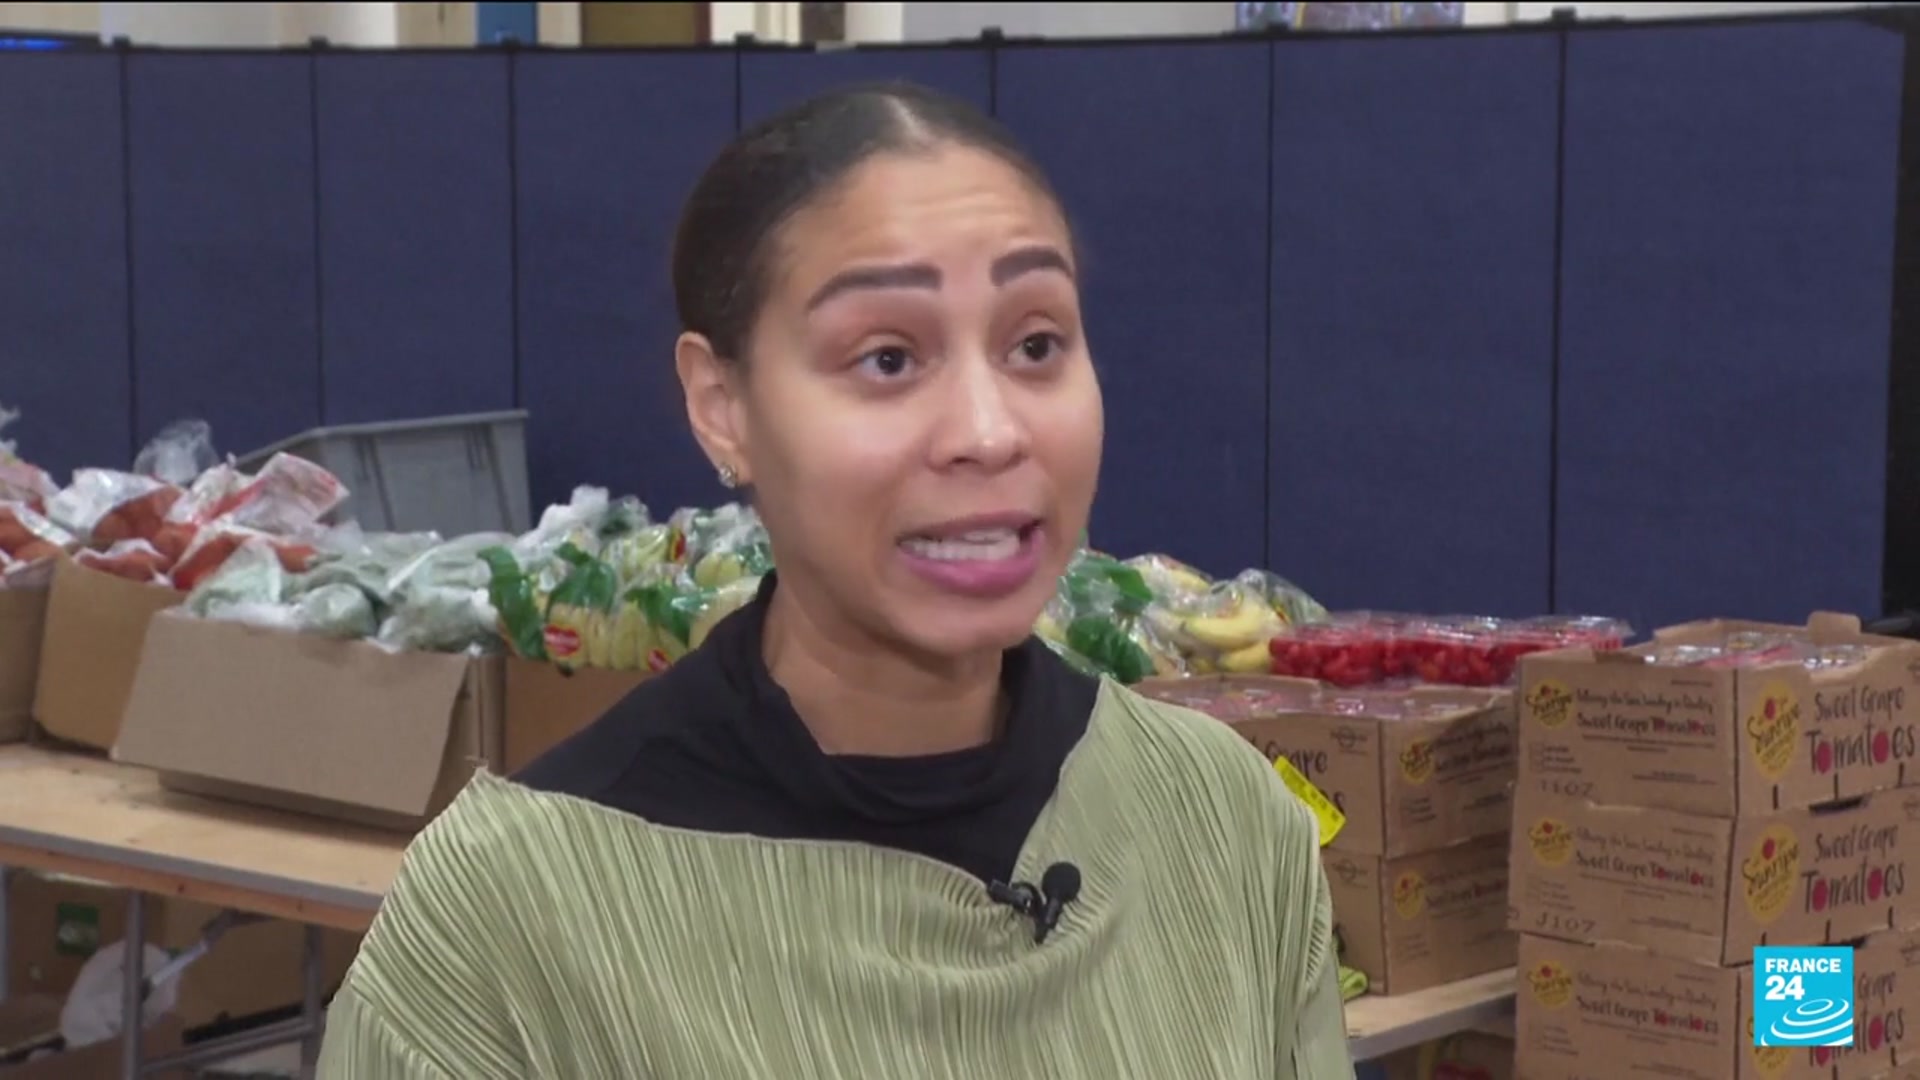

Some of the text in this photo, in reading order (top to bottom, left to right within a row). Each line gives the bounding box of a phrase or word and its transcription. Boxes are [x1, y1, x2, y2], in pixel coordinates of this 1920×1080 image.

[1577, 711, 1612, 730] Sweet
[1814, 685, 1905, 721] Sweet Grape
[1805, 721, 1916, 774] Tomatoes
[1576, 849, 1610, 871] Sweet
[1815, 825, 1899, 862] Sweet Grape
[1801, 857, 1905, 914] Tomatoes
[1857, 972, 1896, 1007] Grape
